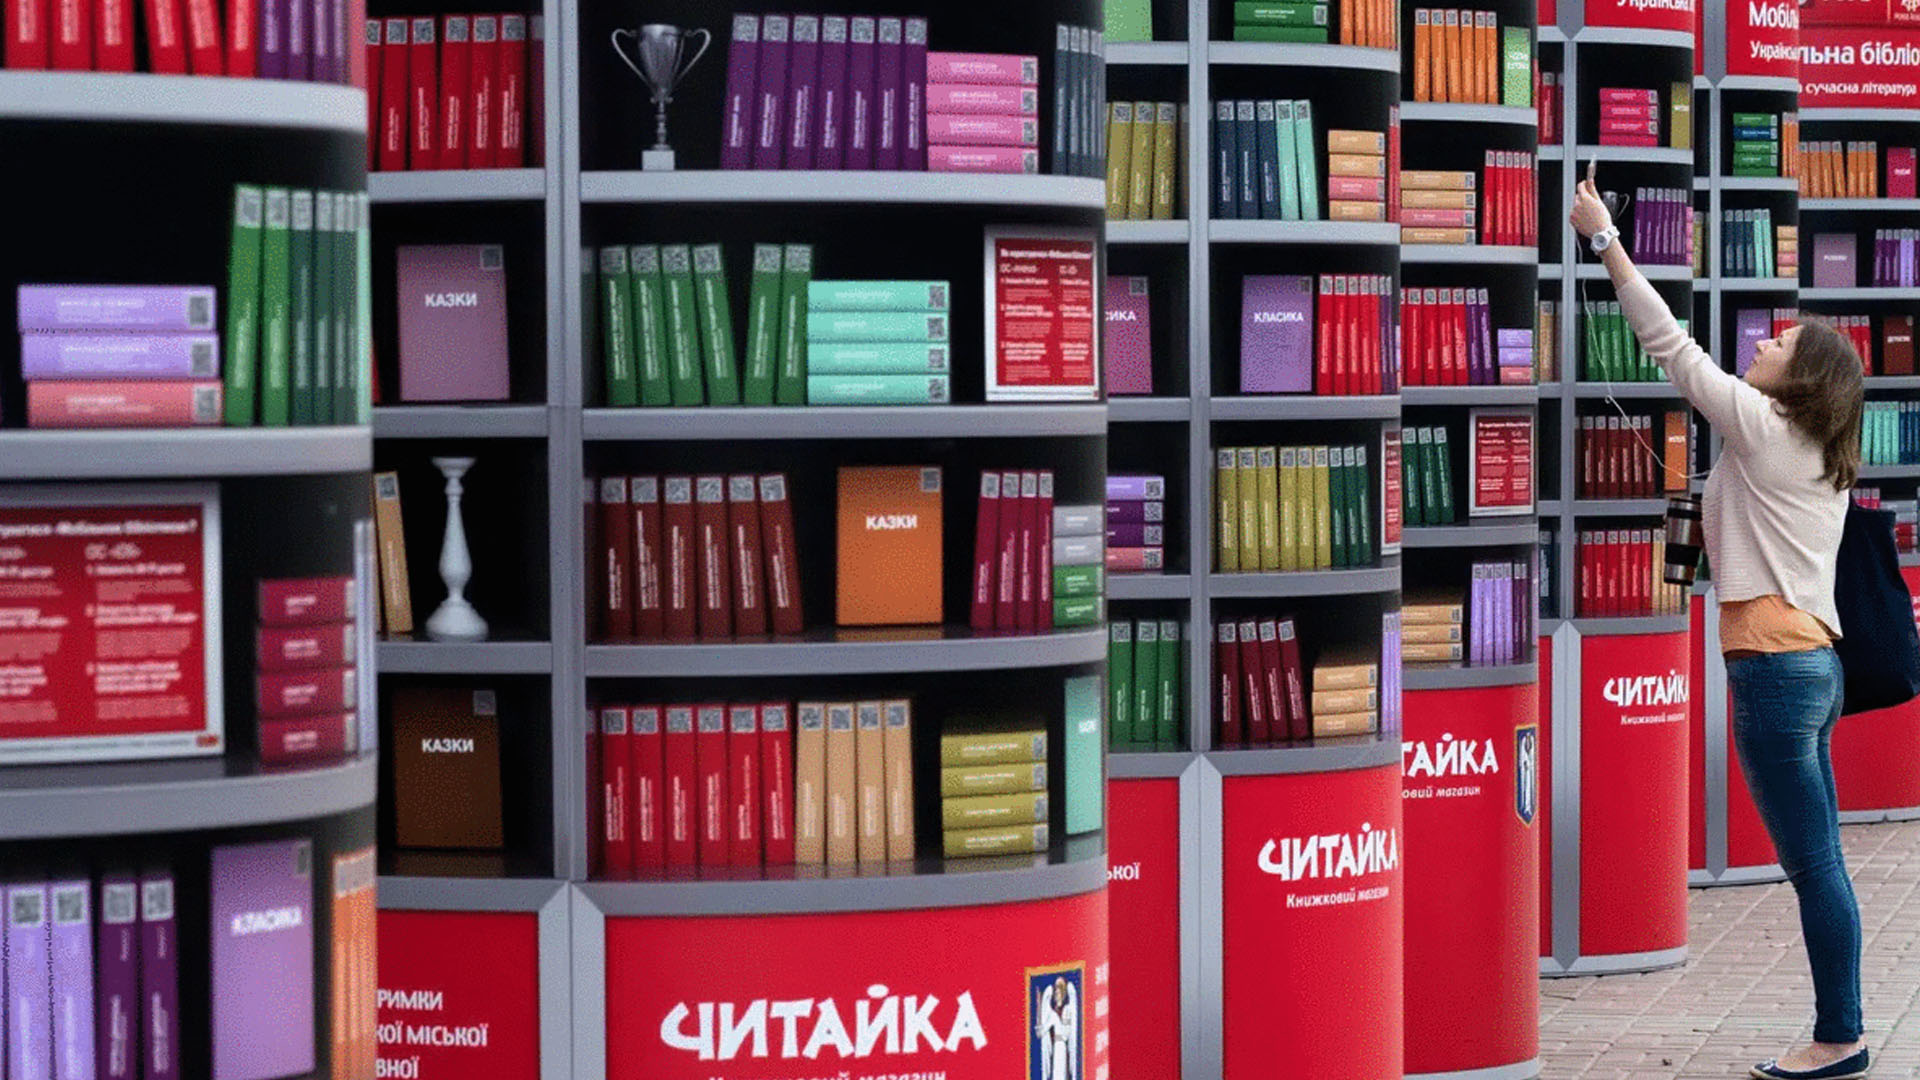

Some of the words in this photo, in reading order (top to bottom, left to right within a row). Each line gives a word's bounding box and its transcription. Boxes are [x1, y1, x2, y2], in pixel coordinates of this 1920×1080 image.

[424, 292, 478, 308] КАЗКИ
[1253, 311, 1304, 323] КЛАСИКА
[865, 514, 918, 530] КАЗКИ
[421, 738, 474, 753] КАЗКИ
[1257, 822, 1399, 882] ЧИТАЙКА
[1286, 887, 1356, 908] Книжковий
[659, 984, 988, 1061] ЧИТАЙКА
[406, 1023, 489, 1047] МІСЬКОЇ
